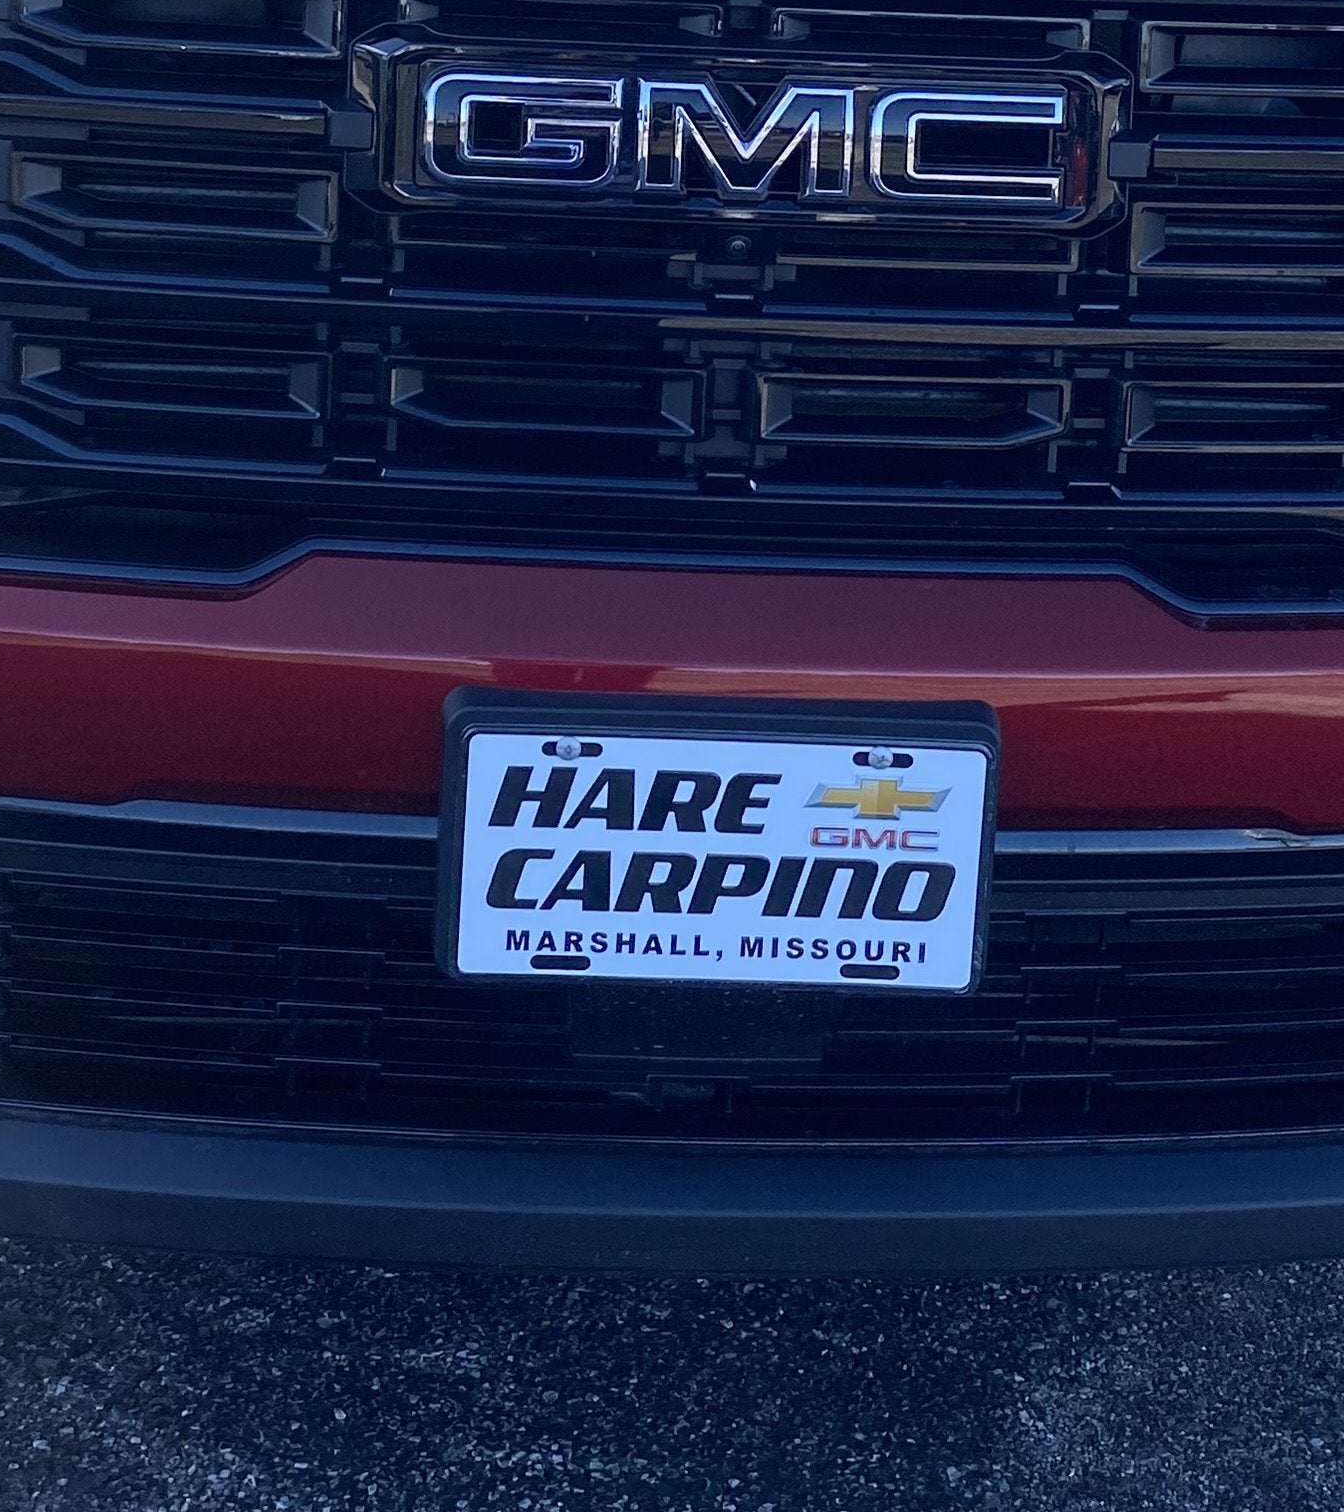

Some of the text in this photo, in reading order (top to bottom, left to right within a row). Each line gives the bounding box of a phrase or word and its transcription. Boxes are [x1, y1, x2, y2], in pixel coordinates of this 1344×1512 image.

[423, 71, 1065, 202] GMC
[487, 765, 783, 834] HARE
[809, 825, 940, 852] GMC
[485, 847, 956, 922] CARPINO
[504, 928, 928, 964] MARSHALL, MISSOURI
